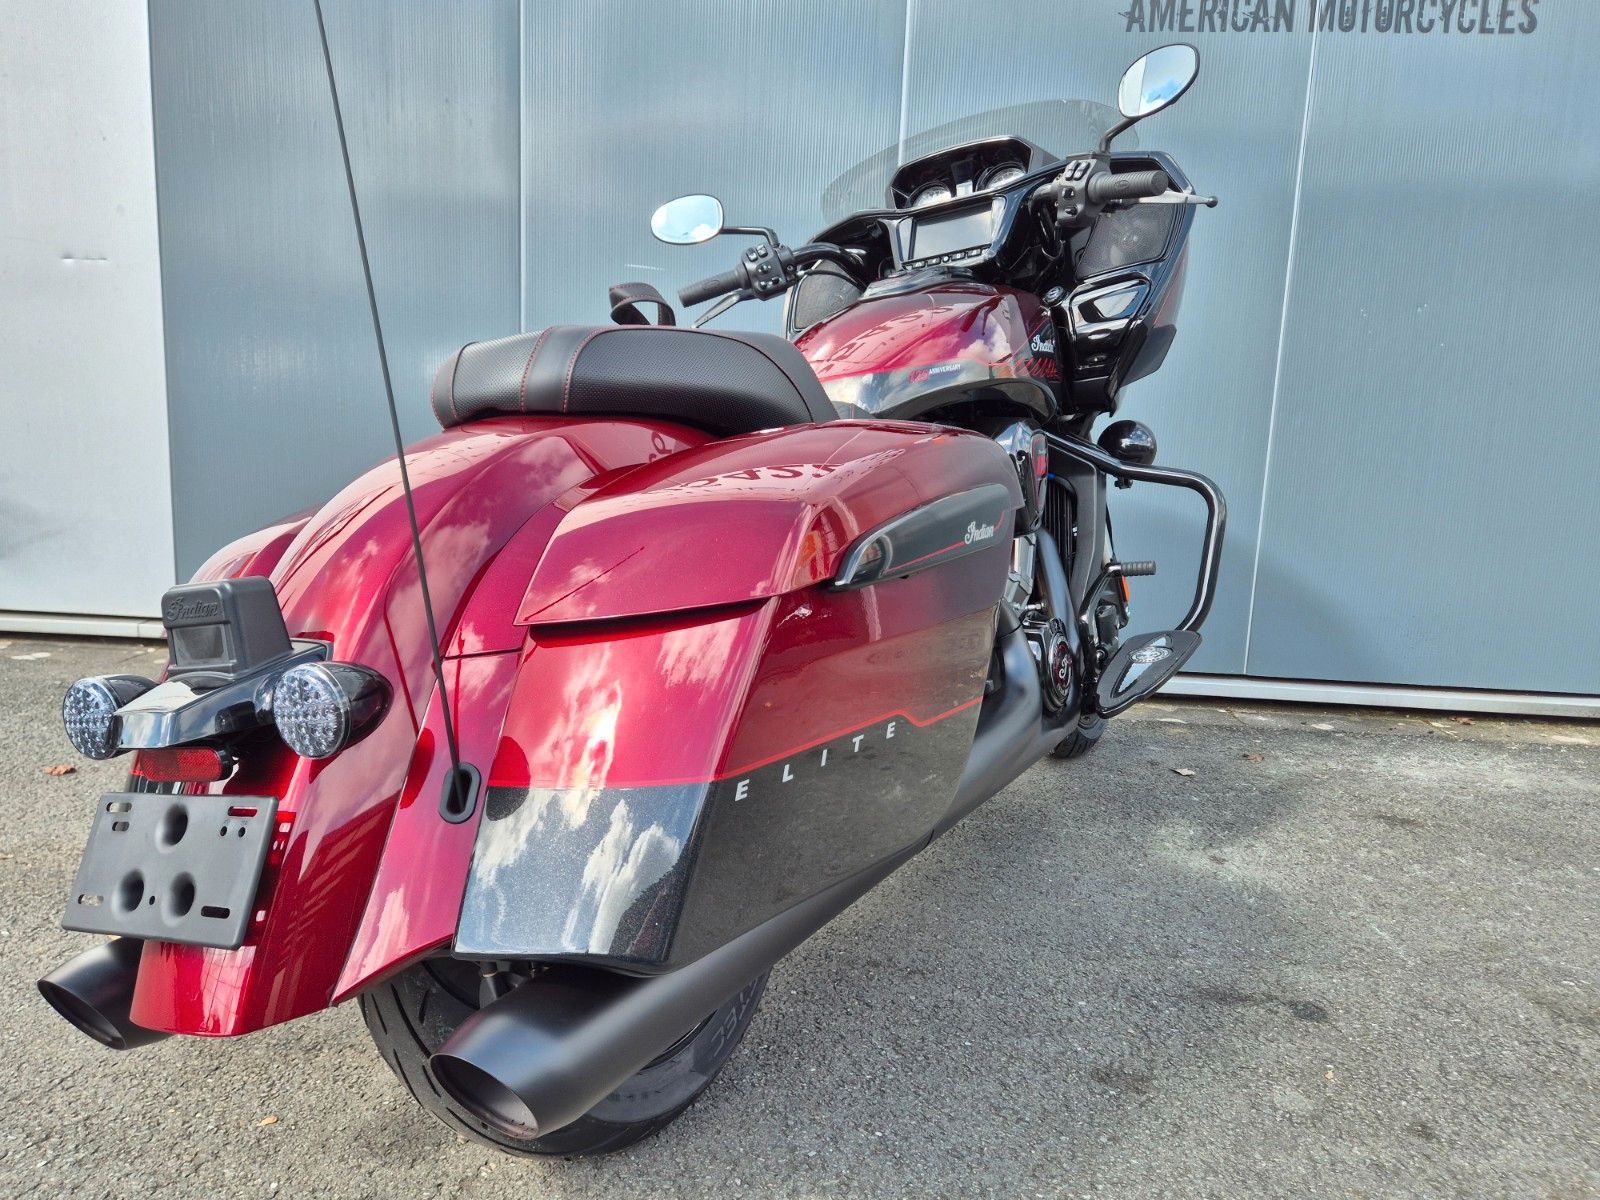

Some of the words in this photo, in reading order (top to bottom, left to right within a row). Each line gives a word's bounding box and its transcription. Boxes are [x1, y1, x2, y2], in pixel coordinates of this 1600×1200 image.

[1121, 0, 1296, 33] AMERICAN
[1307, 0, 1538, 34] MOTORCYCLES
[928, 363, 961, 375] ANNIVERSARY
[964, 520, 995, 545] Indian
[166, 596, 218, 621] Indian
[734, 721, 896, 802] ELITE
